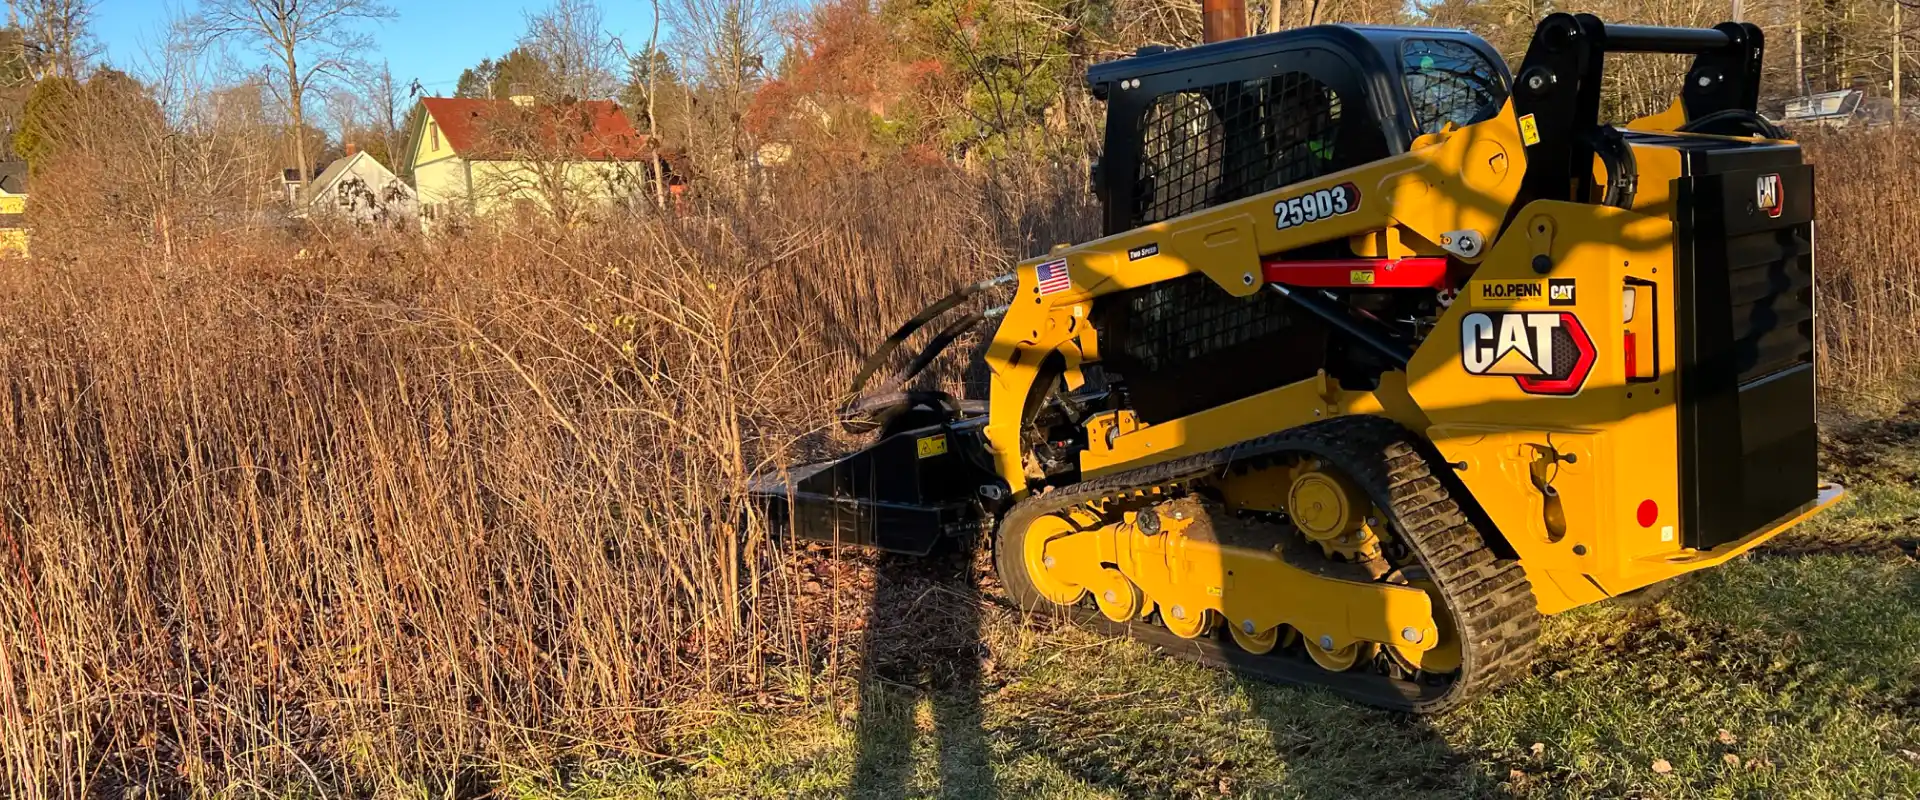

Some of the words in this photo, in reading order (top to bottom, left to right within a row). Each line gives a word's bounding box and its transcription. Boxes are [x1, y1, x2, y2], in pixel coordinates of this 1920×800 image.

[1274, 186, 1348, 229] 259D3
[1757, 176, 1776, 208] CAT
[1550, 285, 1574, 300] CAT
[1462, 312, 1560, 375] CAT
